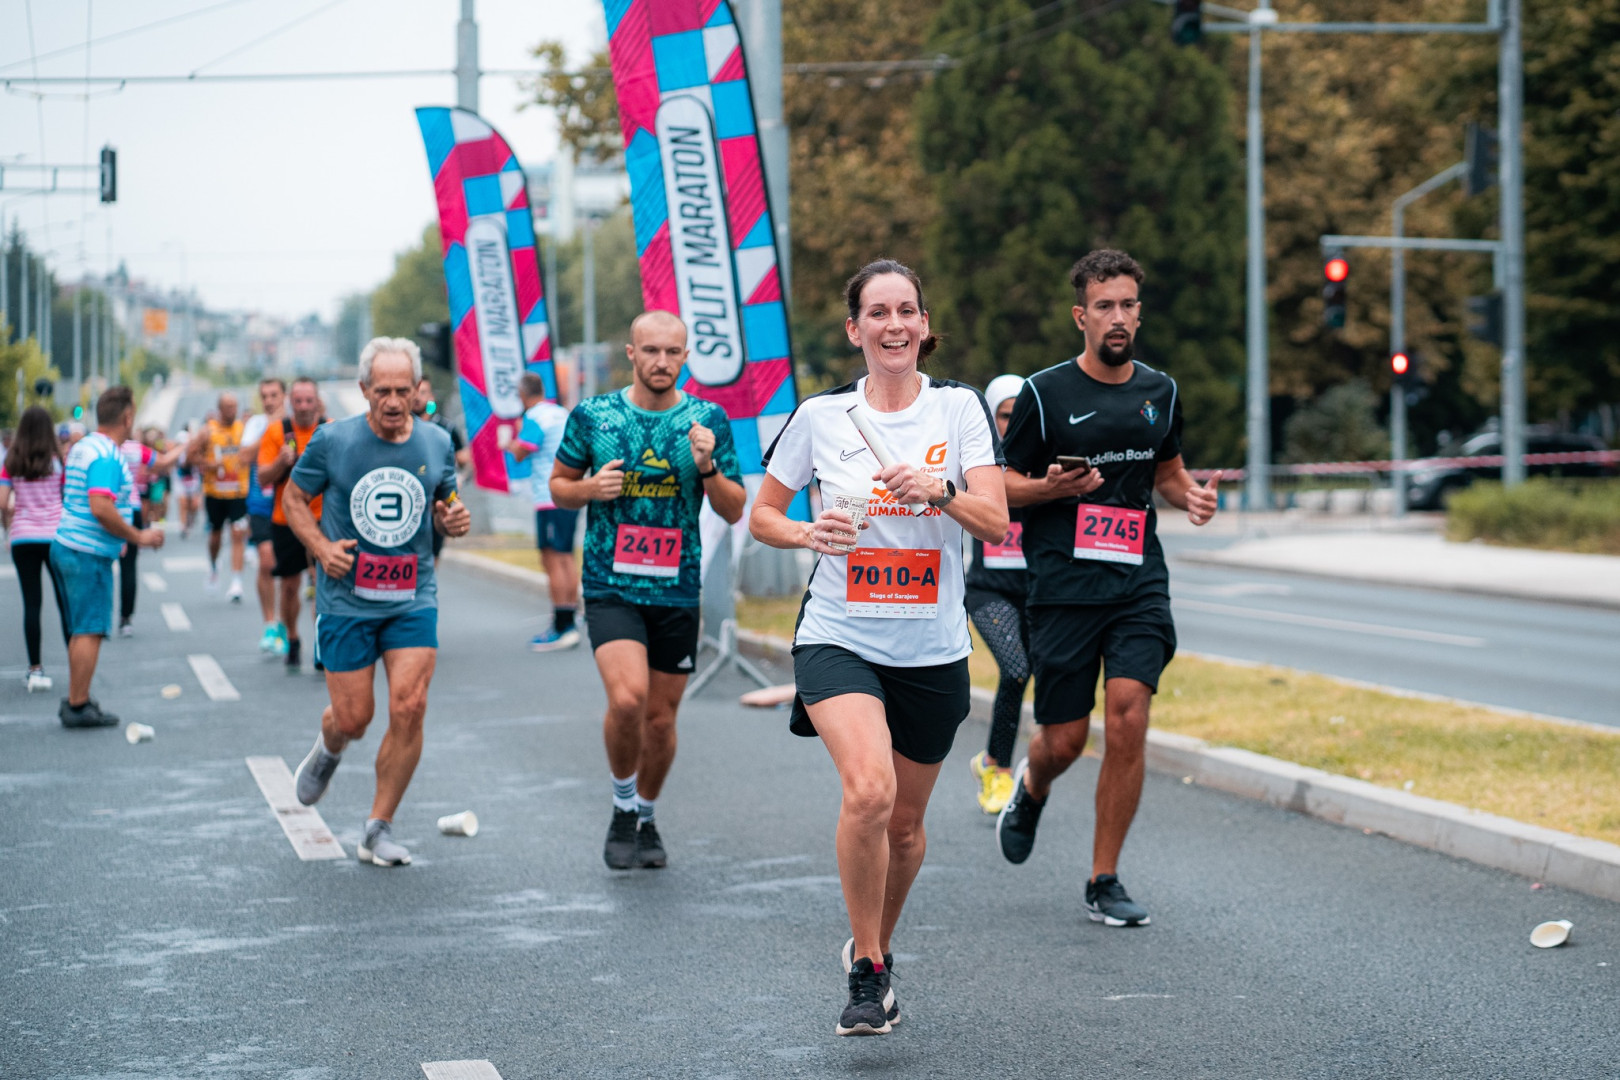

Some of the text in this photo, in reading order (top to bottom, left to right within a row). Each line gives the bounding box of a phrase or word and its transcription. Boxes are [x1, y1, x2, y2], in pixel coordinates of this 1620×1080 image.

[667, 126, 732, 358] SPLIT MARATON
[475, 238, 519, 399] SPLIT MARATON
[1125, 447, 1156, 461] Bank
[374, 493, 403, 521] 3
[865, 505, 942, 517] UMARAON
[1083, 515, 1139, 541] 2745
[622, 534, 677, 556] 2417
[362, 561, 413, 581] 2260
[850, 565, 937, 587] 7010-A
